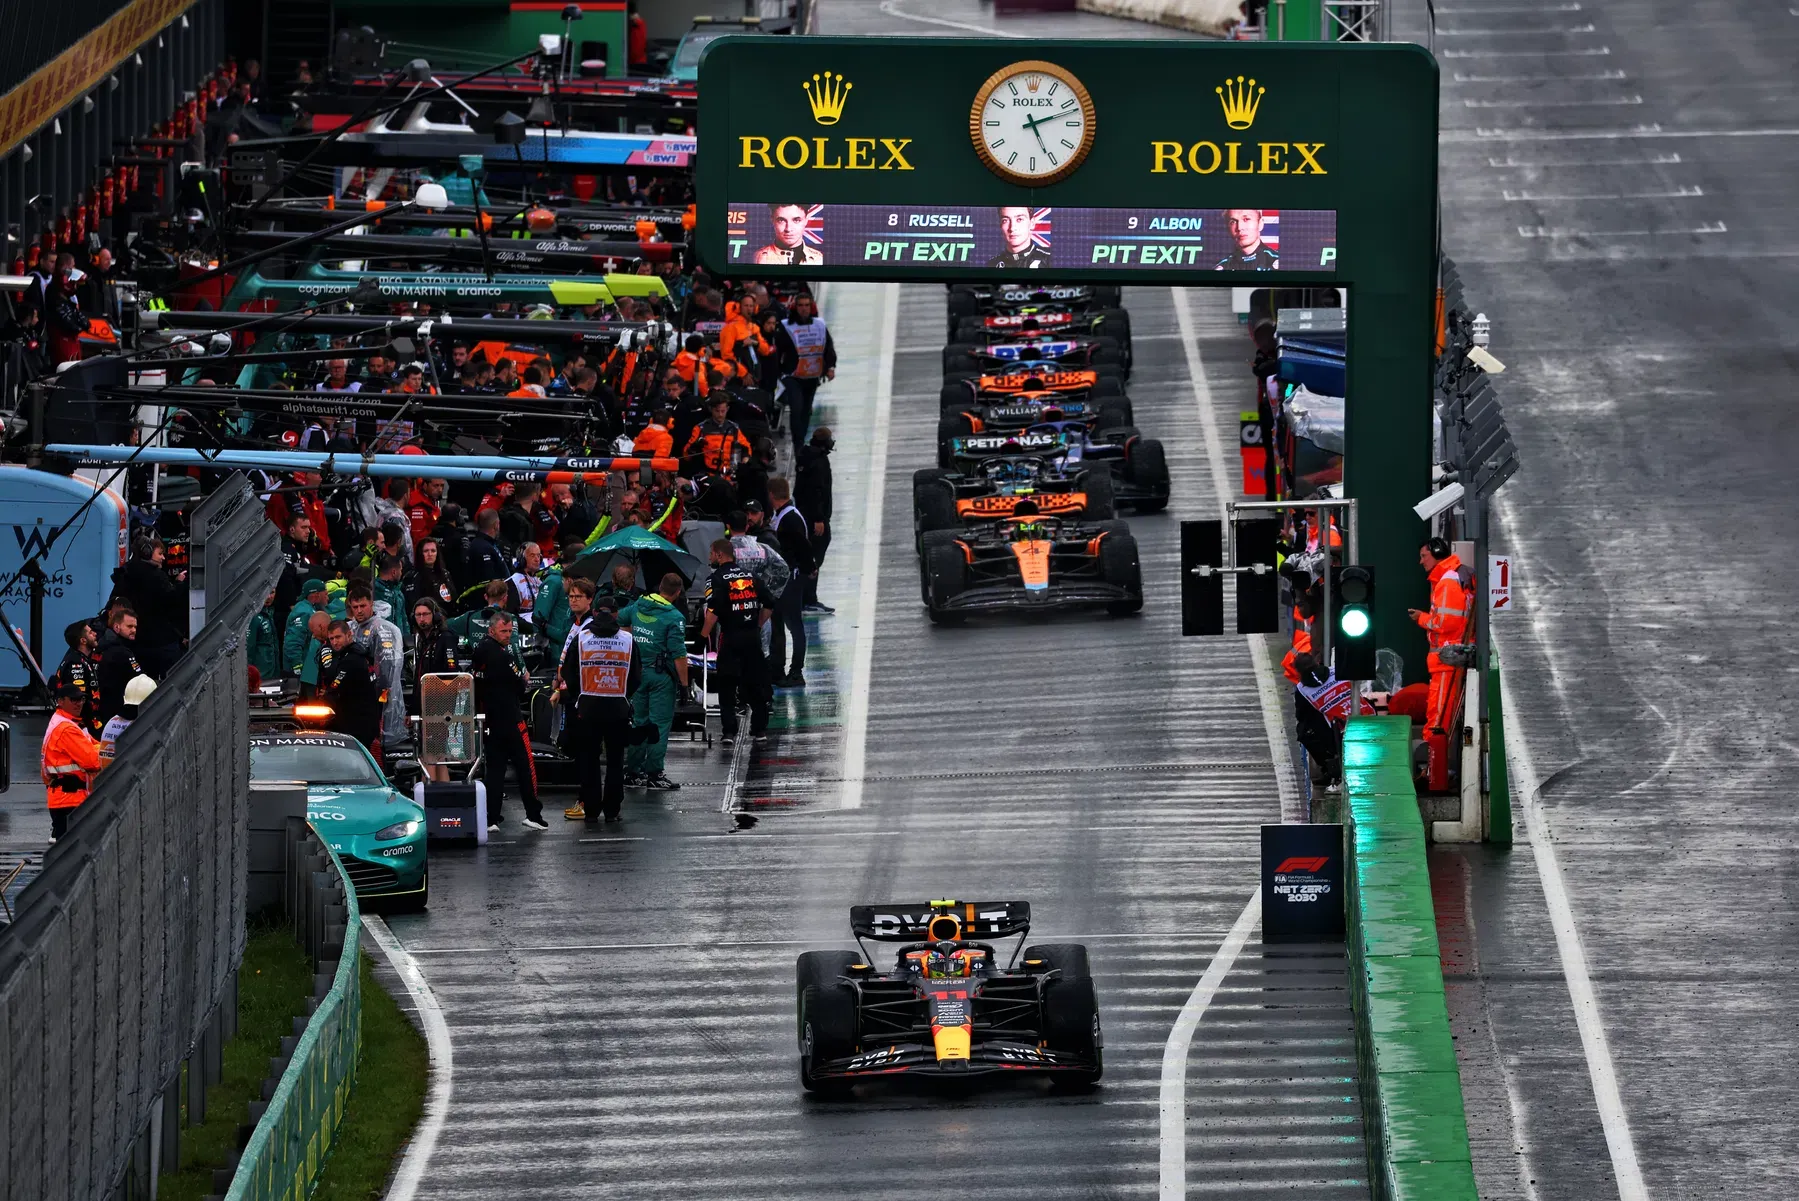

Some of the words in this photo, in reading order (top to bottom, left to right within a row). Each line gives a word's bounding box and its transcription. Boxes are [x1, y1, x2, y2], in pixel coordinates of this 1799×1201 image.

[1012, 98, 1054, 107] ROLEX
[653, 154, 677, 163] BWT
[738, 135, 915, 171] ROLEX
[1150, 140, 1328, 175] ROLEX
[647, 215, 682, 225] WORLD
[887, 213, 898, 226] 8
[908, 214, 974, 228] RUSSELL
[1127, 216, 1139, 229] 9
[1149, 217, 1202, 230] ALBON
[589, 223, 602, 232] DP
[602, 224, 636, 233] WORLD
[536, 241, 556, 253] Alfa
[864, 241, 909, 261] PIT
[912, 242, 976, 262] EXIT
[496, 251, 515, 262] Alfa
[1091, 245, 1137, 264] PIT
[1139, 245, 1203, 265] EXIT
[298, 284, 351, 296] cognizant
[403, 285, 446, 297] MARTIN
[457, 286, 501, 296] aramco
[1005, 287, 1084, 301] cozant
[993, 313, 1064, 325] OREN
[282, 402, 377, 417] alphataurif1.com
[997, 407, 1038, 416] WILLIAM
[967, 434, 1052, 448] PETRNAS
[567, 458, 600, 469] Gulf
[505, 470, 536, 482] Gulf
[0, 572, 74, 585] WILAMS
[5, 586, 64, 598] RACNG
[732, 601, 753, 611] Mobil
[599, 667, 616, 676] PIT
[593, 675, 620, 683] LANE
[276, 738, 345, 748] MARTIN
[383, 845, 414, 857] aramco
[1273, 885, 1299, 894] NET
[1299, 884, 1331, 894] ZERO
[1287, 893, 1318, 902] 2030
